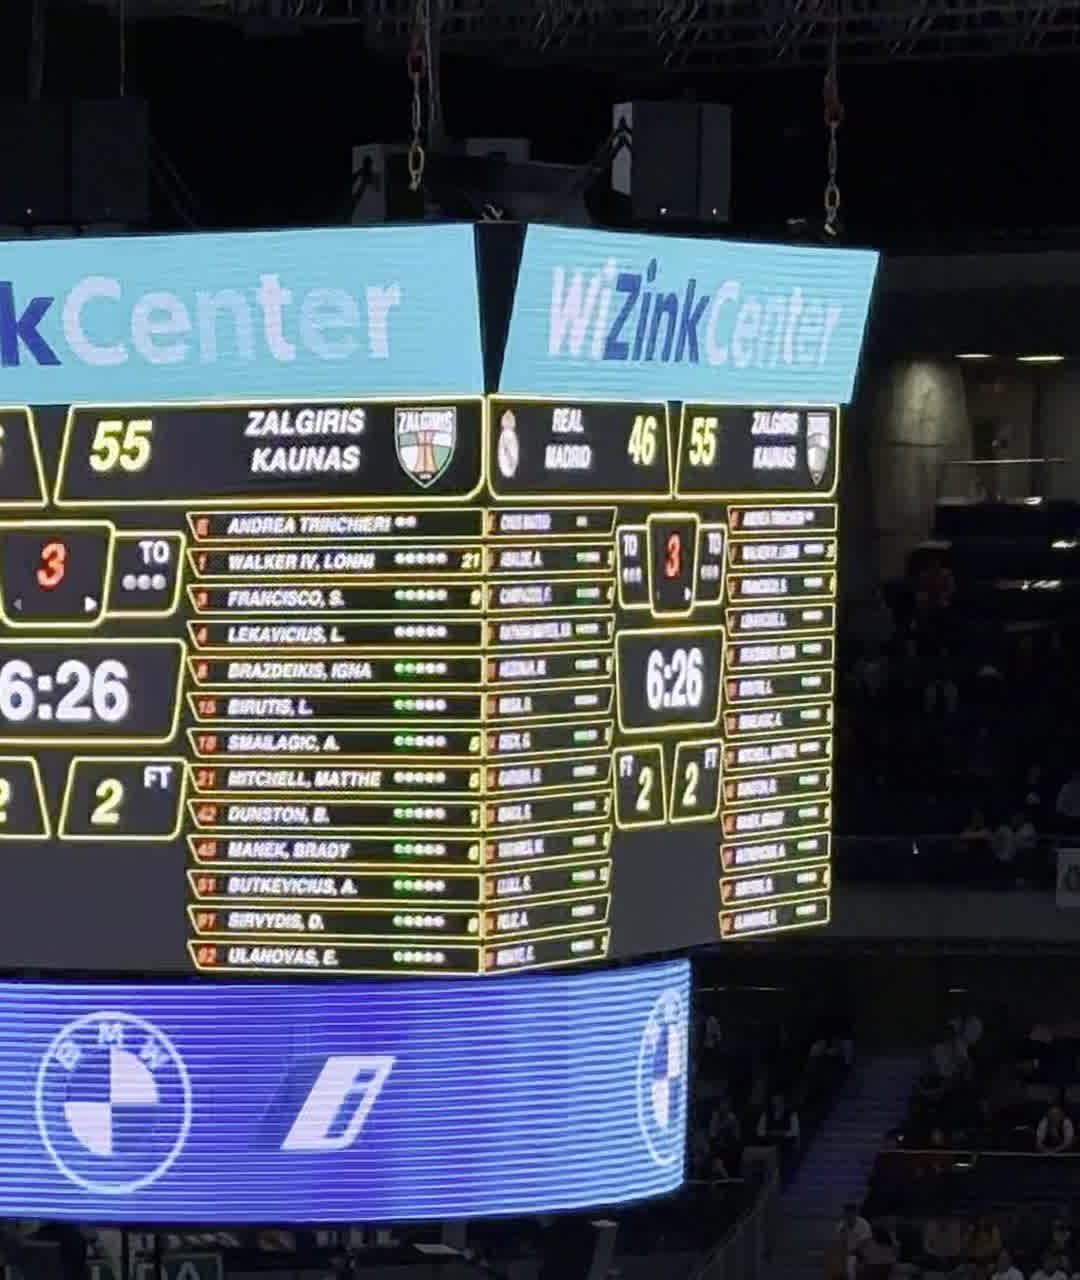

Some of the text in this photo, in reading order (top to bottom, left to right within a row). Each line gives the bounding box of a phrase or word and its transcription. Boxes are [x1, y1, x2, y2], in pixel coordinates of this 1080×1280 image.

[245, 409, 366, 437] ZALGIRIS
[88, 419, 153, 472] 55
[628, 415, 657, 466] 46
[689, 416, 719, 467] 55
[250, 446, 361, 473] KAUNAS
[227, 517, 295, 535] ANDREA
[138, 540, 170, 564] TO
[623, 534, 638, 556] TO
[665, 532, 681, 579] 3
[36, 543, 67, 587] 3
[228, 554, 300, 571] WALKER
[461, 553, 480, 568] 21
[227, 590, 325, 607] FRANCISCO,
[330, 627, 345, 642] L.
[646, 647, 703, 711] 6:26
[298, 699, 313, 715] L.
[323, 736, 340, 751] A.
[143, 765, 173, 788] FT
[635, 766, 654, 811] 2
[682, 761, 700, 806] 2
[89, 778, 124, 825] 2
[340, 879, 358, 895] A.
